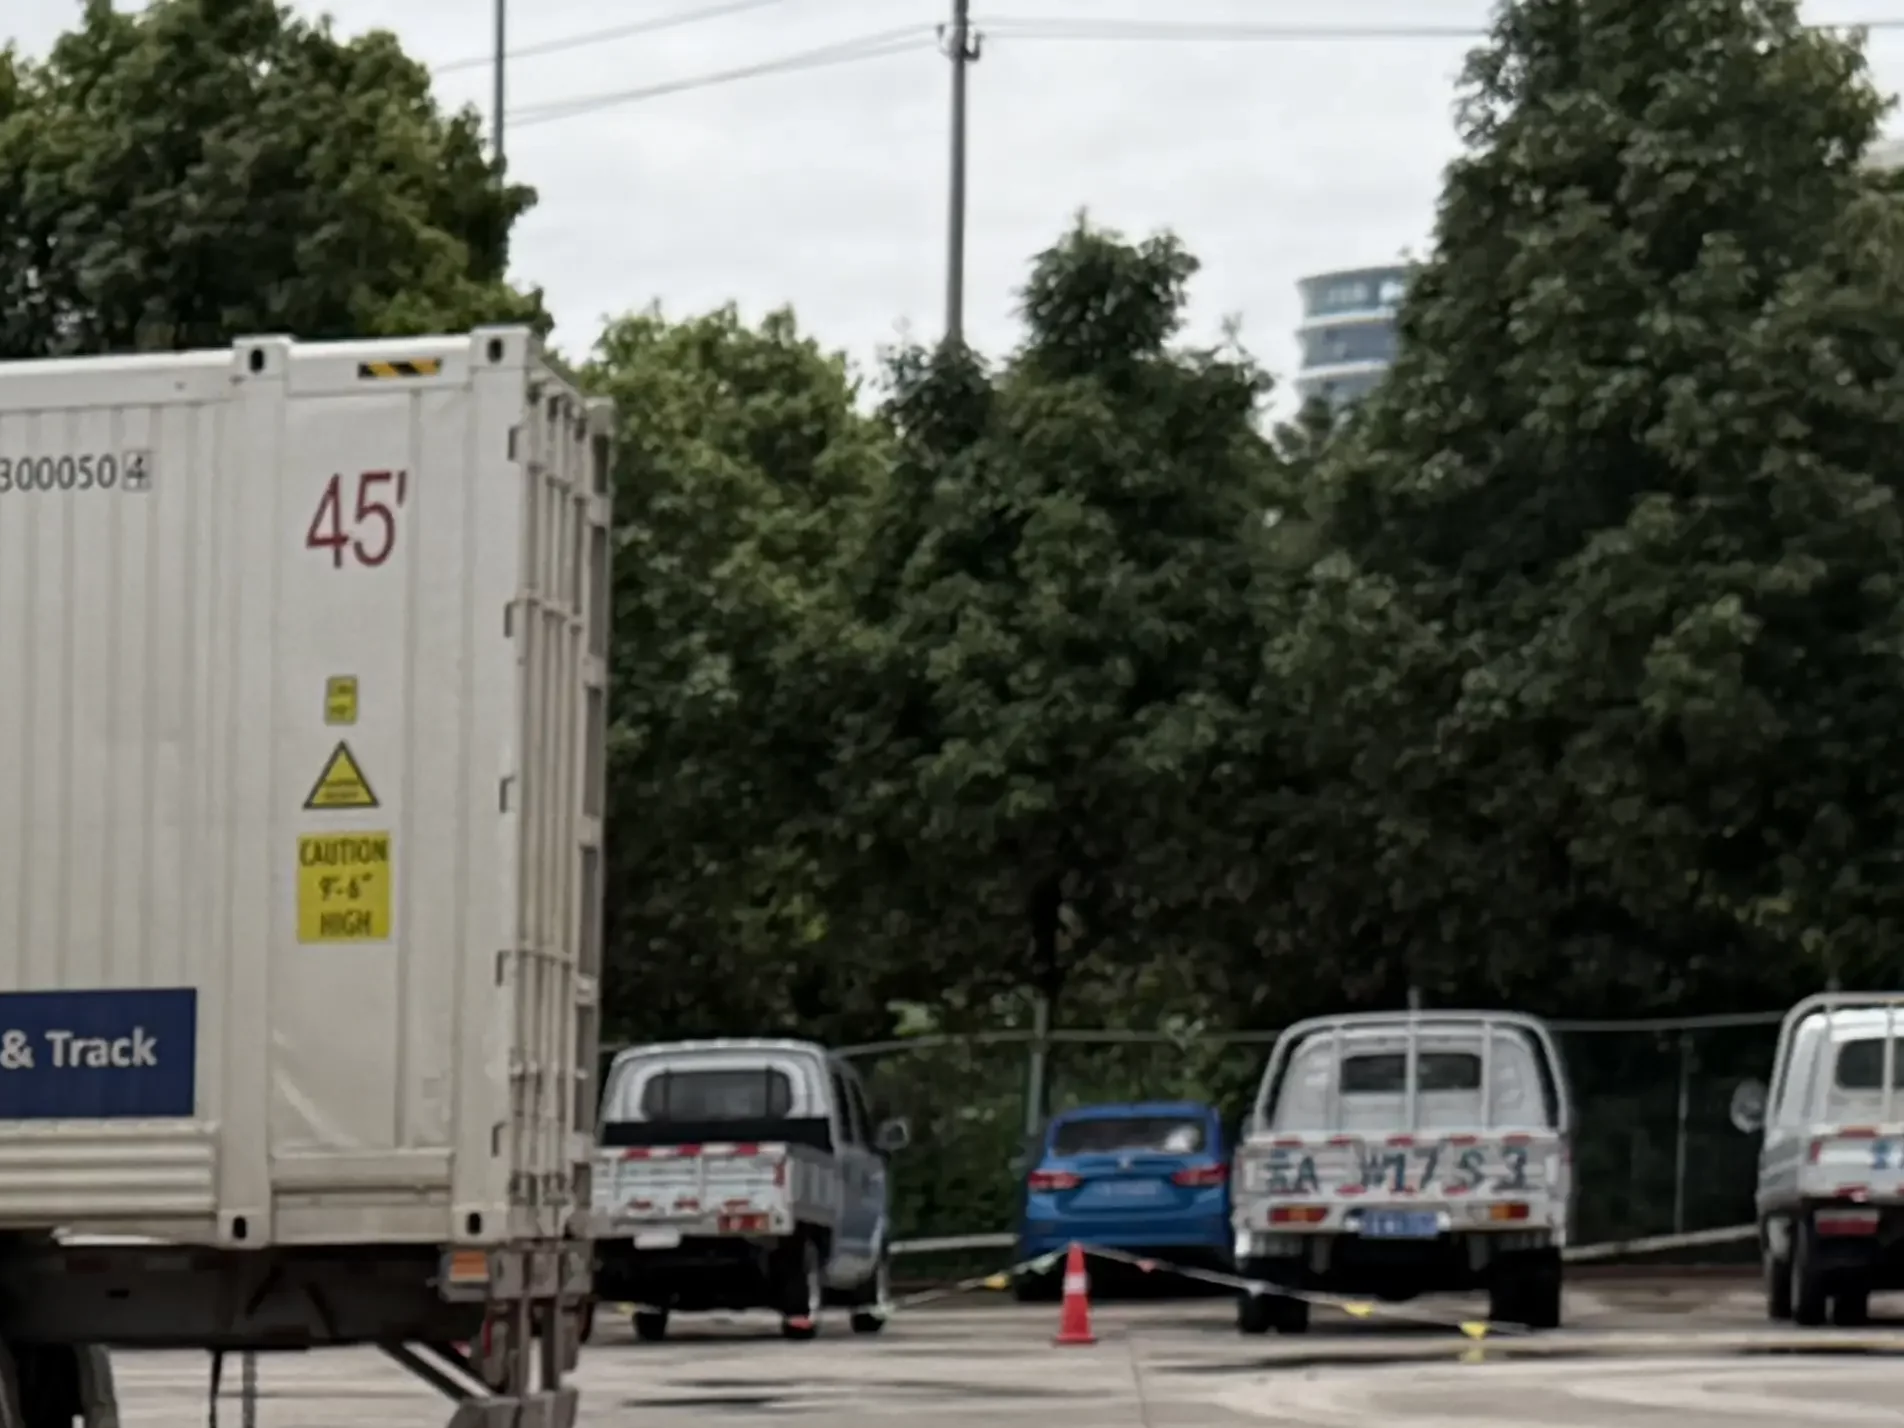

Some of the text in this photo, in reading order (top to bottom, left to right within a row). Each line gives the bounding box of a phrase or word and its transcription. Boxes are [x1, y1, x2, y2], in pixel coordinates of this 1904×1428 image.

[306, 470, 408, 569] 45'
[299, 838, 389, 868] CAUTION
[319, 908, 372, 938] HIGH
[44, 1026, 158, 1068] Track
